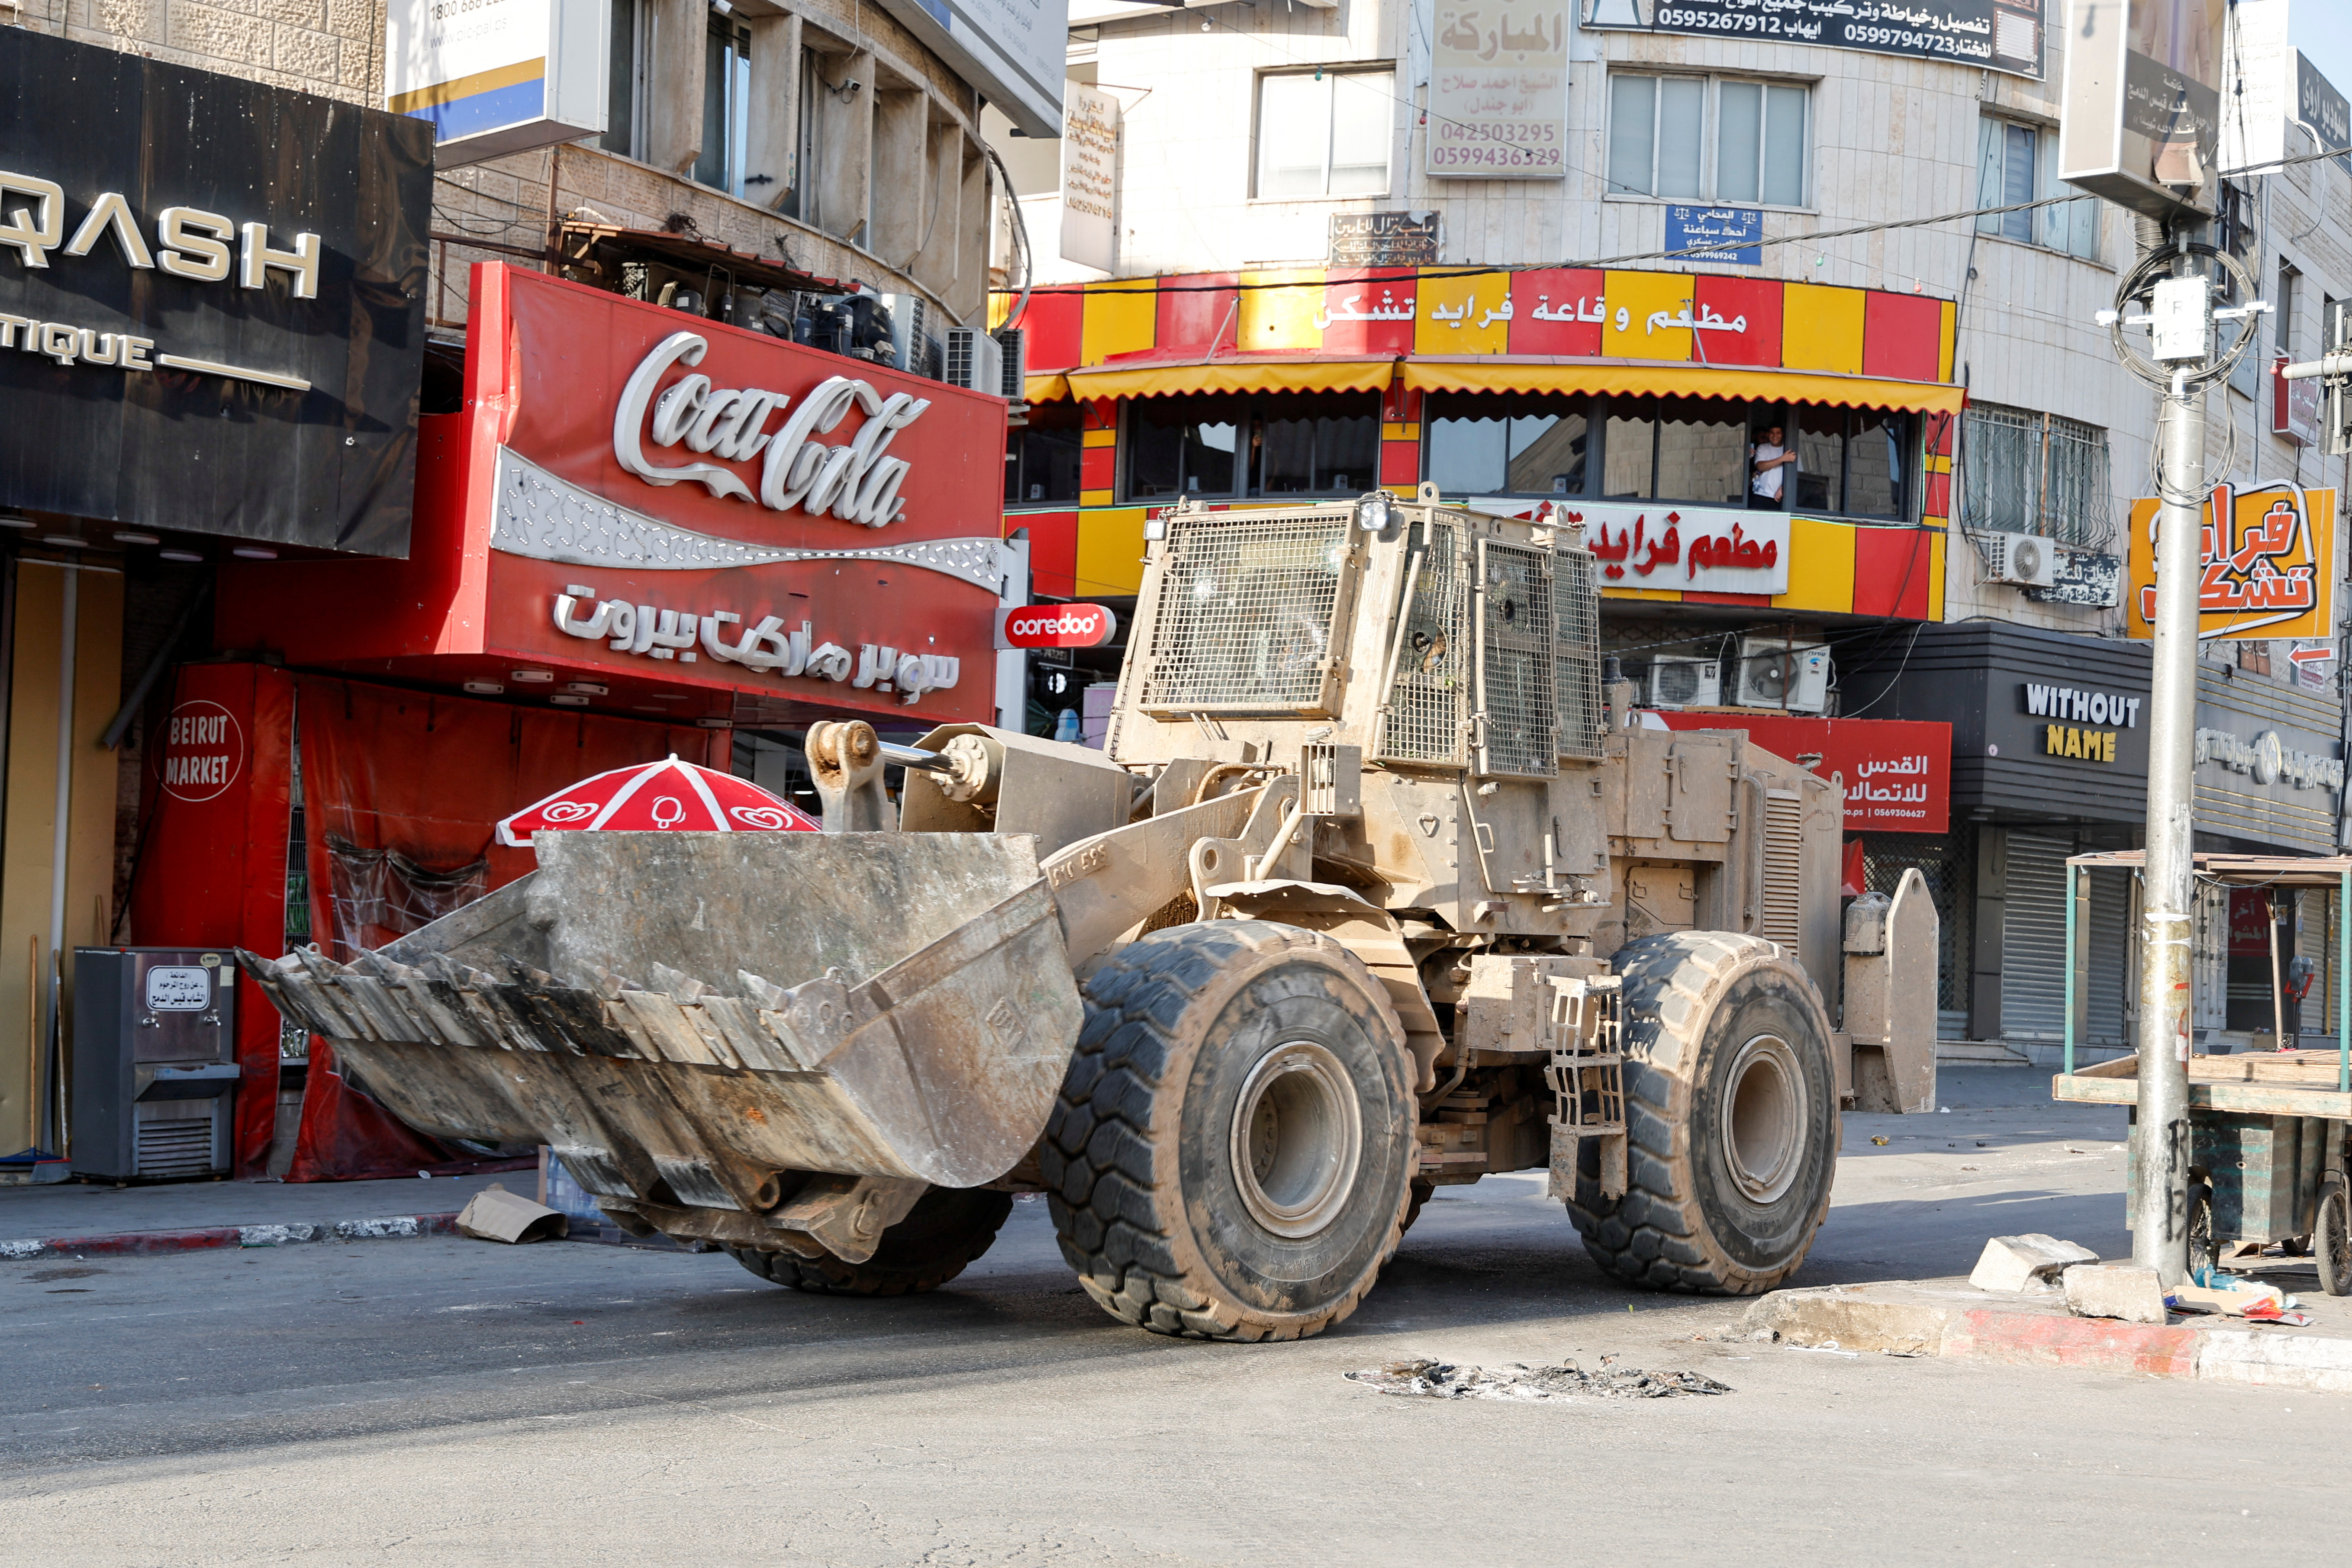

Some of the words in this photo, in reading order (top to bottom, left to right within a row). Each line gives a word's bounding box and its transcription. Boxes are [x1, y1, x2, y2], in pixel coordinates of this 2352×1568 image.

[430, 0, 457, 21] 1800
[1659, 9, 1780, 33] 0595267912
[1881, 4, 1937, 31] وخياطة
[1940, 13, 1990, 34] تفصيل
[1441, 11, 1562, 61] المباركة
[1845, 24, 1955, 53] 0599794723
[1954, 38, 1991, 59] المختار
[1441, 75, 1478, 93] صلاح
[1519, 73, 1557, 94] الشيخ
[2321, 99, 2346, 142] ستوديو
[1441, 123, 1554, 142] 042503295
[1434, 147, 1560, 166] 0599436329
[1698, 209, 1734, 223] المحامي
[1683, 224, 1720, 238] سباعنة
[1690, 251, 1737, 261] 0599969242
[1313, 290, 1416, 329] تشكن
[1431, 292, 1514, 329] فرايد
[1646, 303, 1747, 335] مطعم
[614, 331, 931, 529] Coca-Cola
[1588, 511, 1681, 580] فرايد
[1687, 521, 1778, 580] مطعم
[554, 584, 698, 663] بيروت
[1013, 612, 1099, 635] ooredoo
[853, 644, 959, 706] سوبر
[2027, 683, 2140, 728] WITHOUT
[171, 715, 228, 745] BEIRUT
[2047, 724, 2116, 763] NAME
[166, 756, 229, 786] MARKET
[1858, 755, 1927, 778] القدس
[1874, 808, 1926, 818] 0569306627
[2229, 925, 2267, 943] المشوا
[159, 981, 178, 989] المرحوم
[171, 992, 185, 1005] قيس
[187, 992, 206, 1005] الشاب
